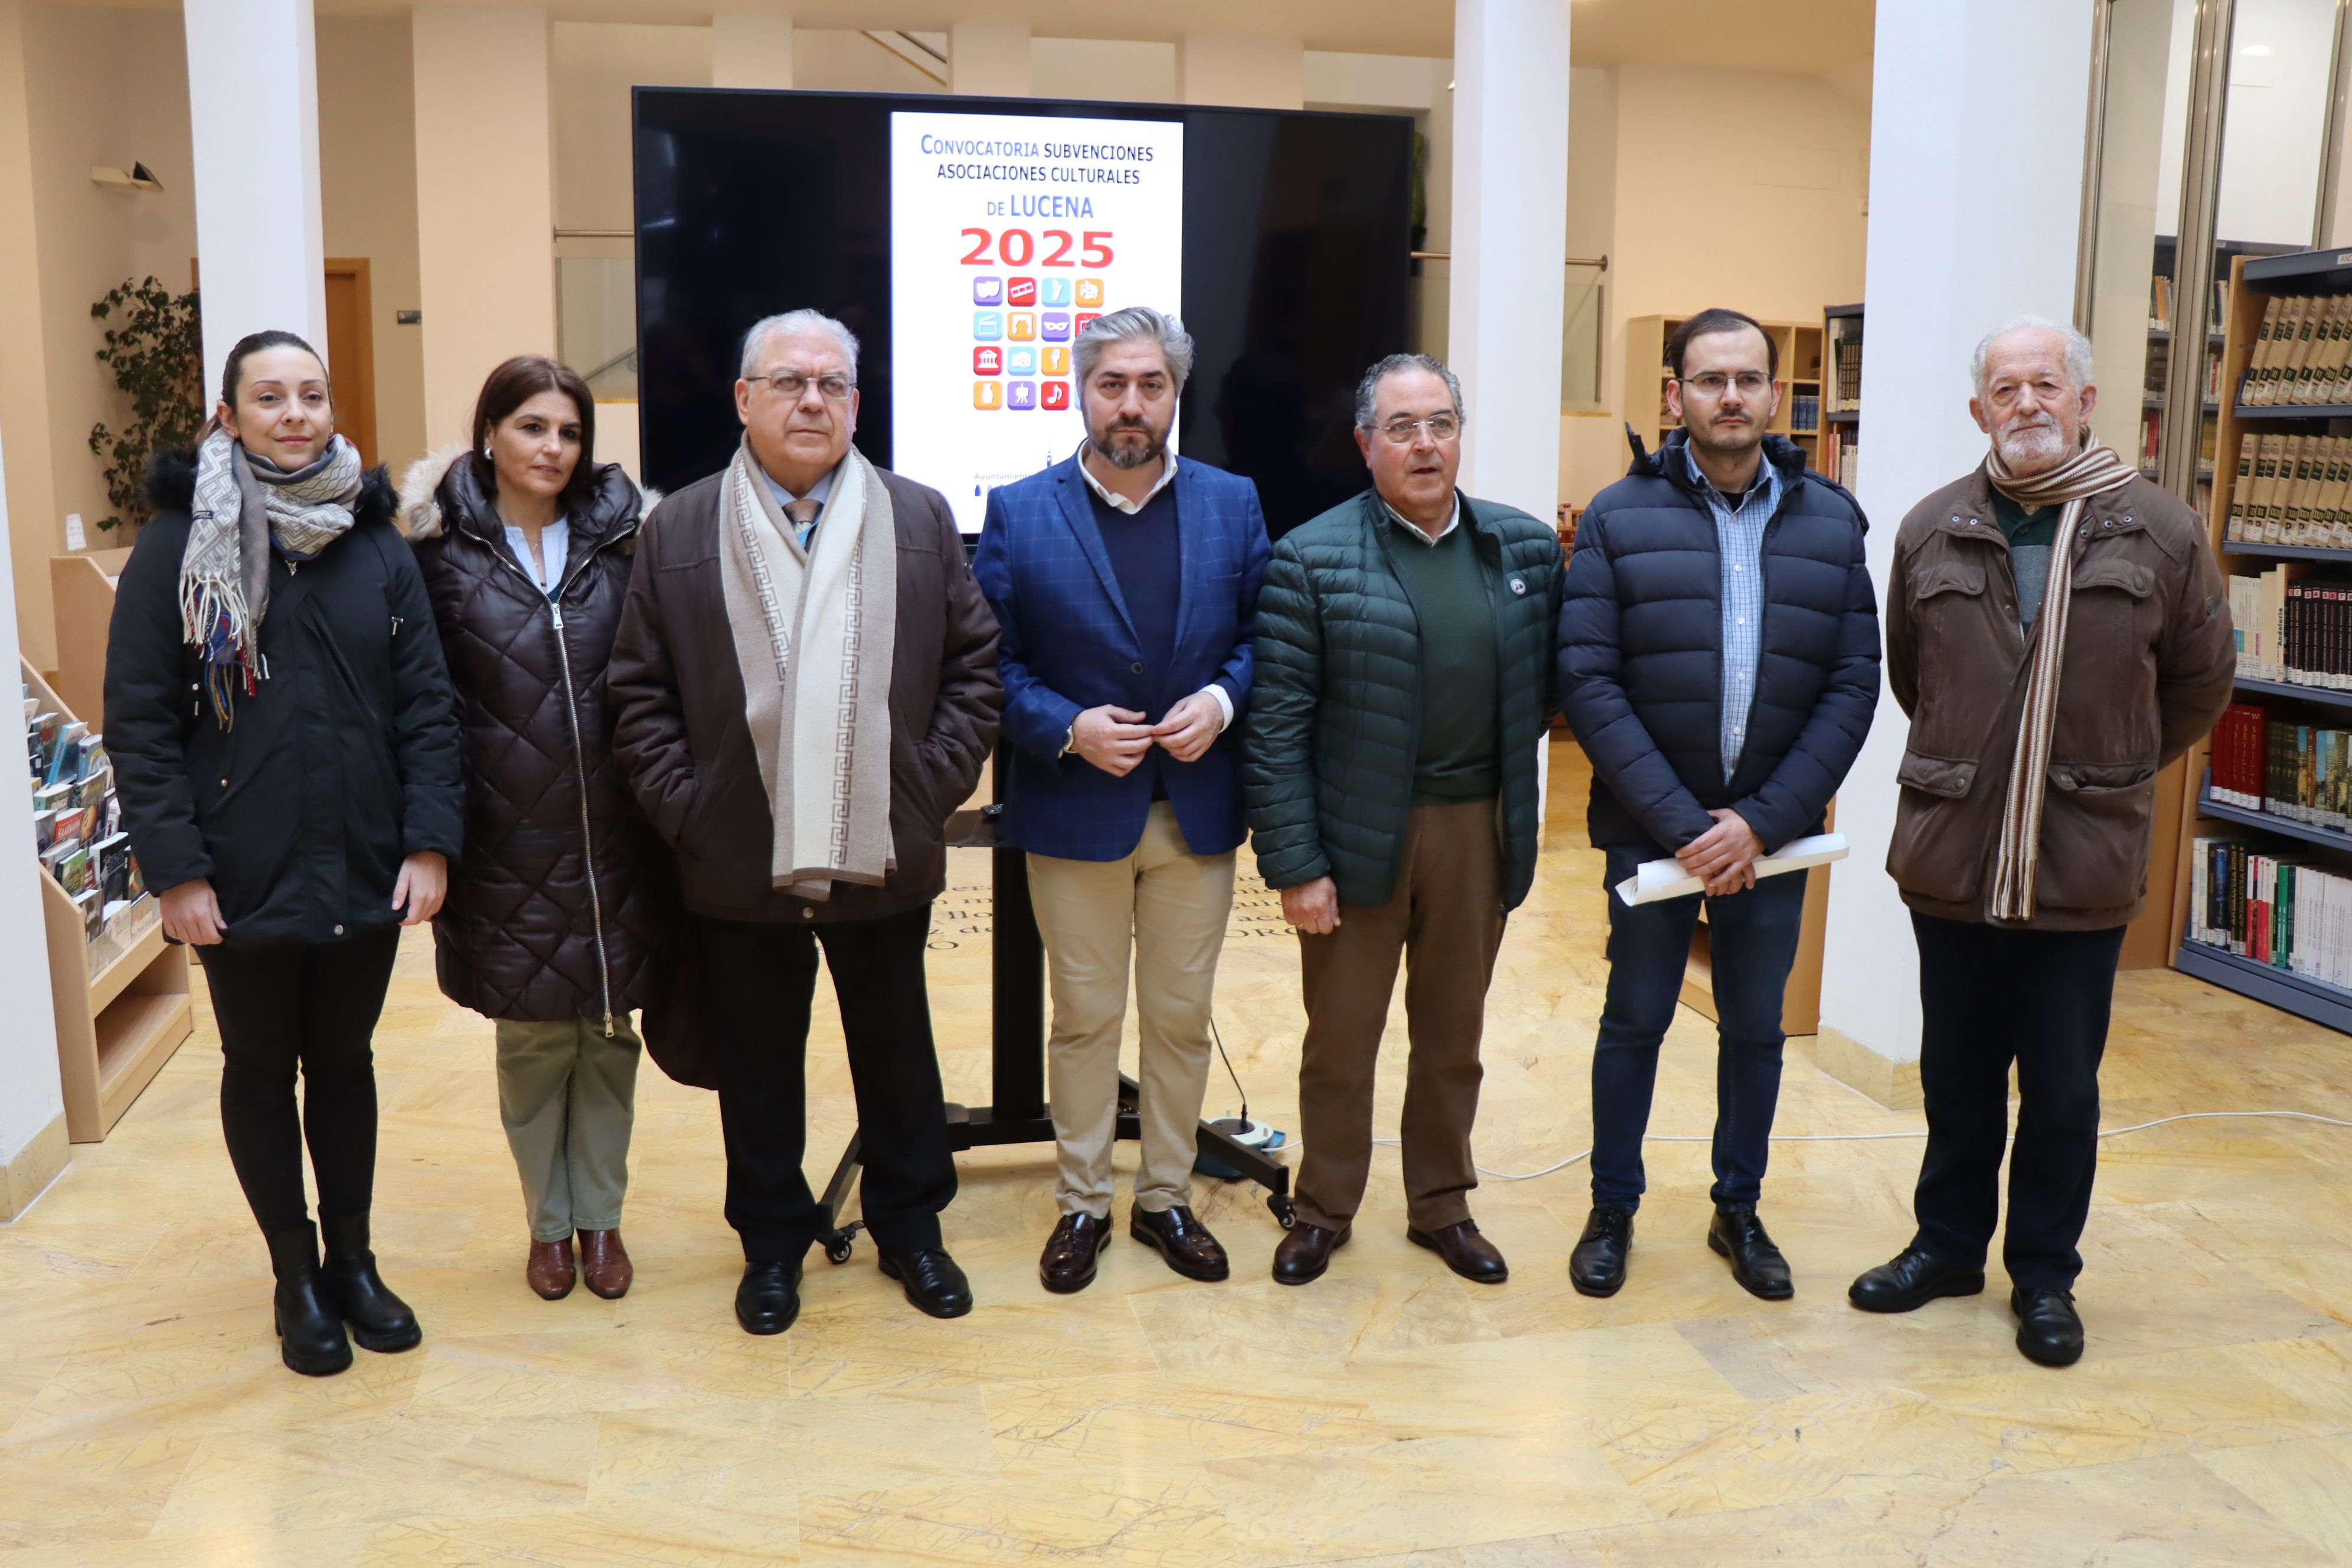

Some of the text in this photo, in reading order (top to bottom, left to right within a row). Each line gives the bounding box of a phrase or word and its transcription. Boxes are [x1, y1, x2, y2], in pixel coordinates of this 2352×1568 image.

[921, 134, 1154, 162] CONVOCATORIA SUBVENCIONES
[937, 164, 1140, 184] ASOCIACIONES CULTURALES
[987, 195, 1093, 218] DE LUCENA
[960, 227, 1115, 269] 2025
